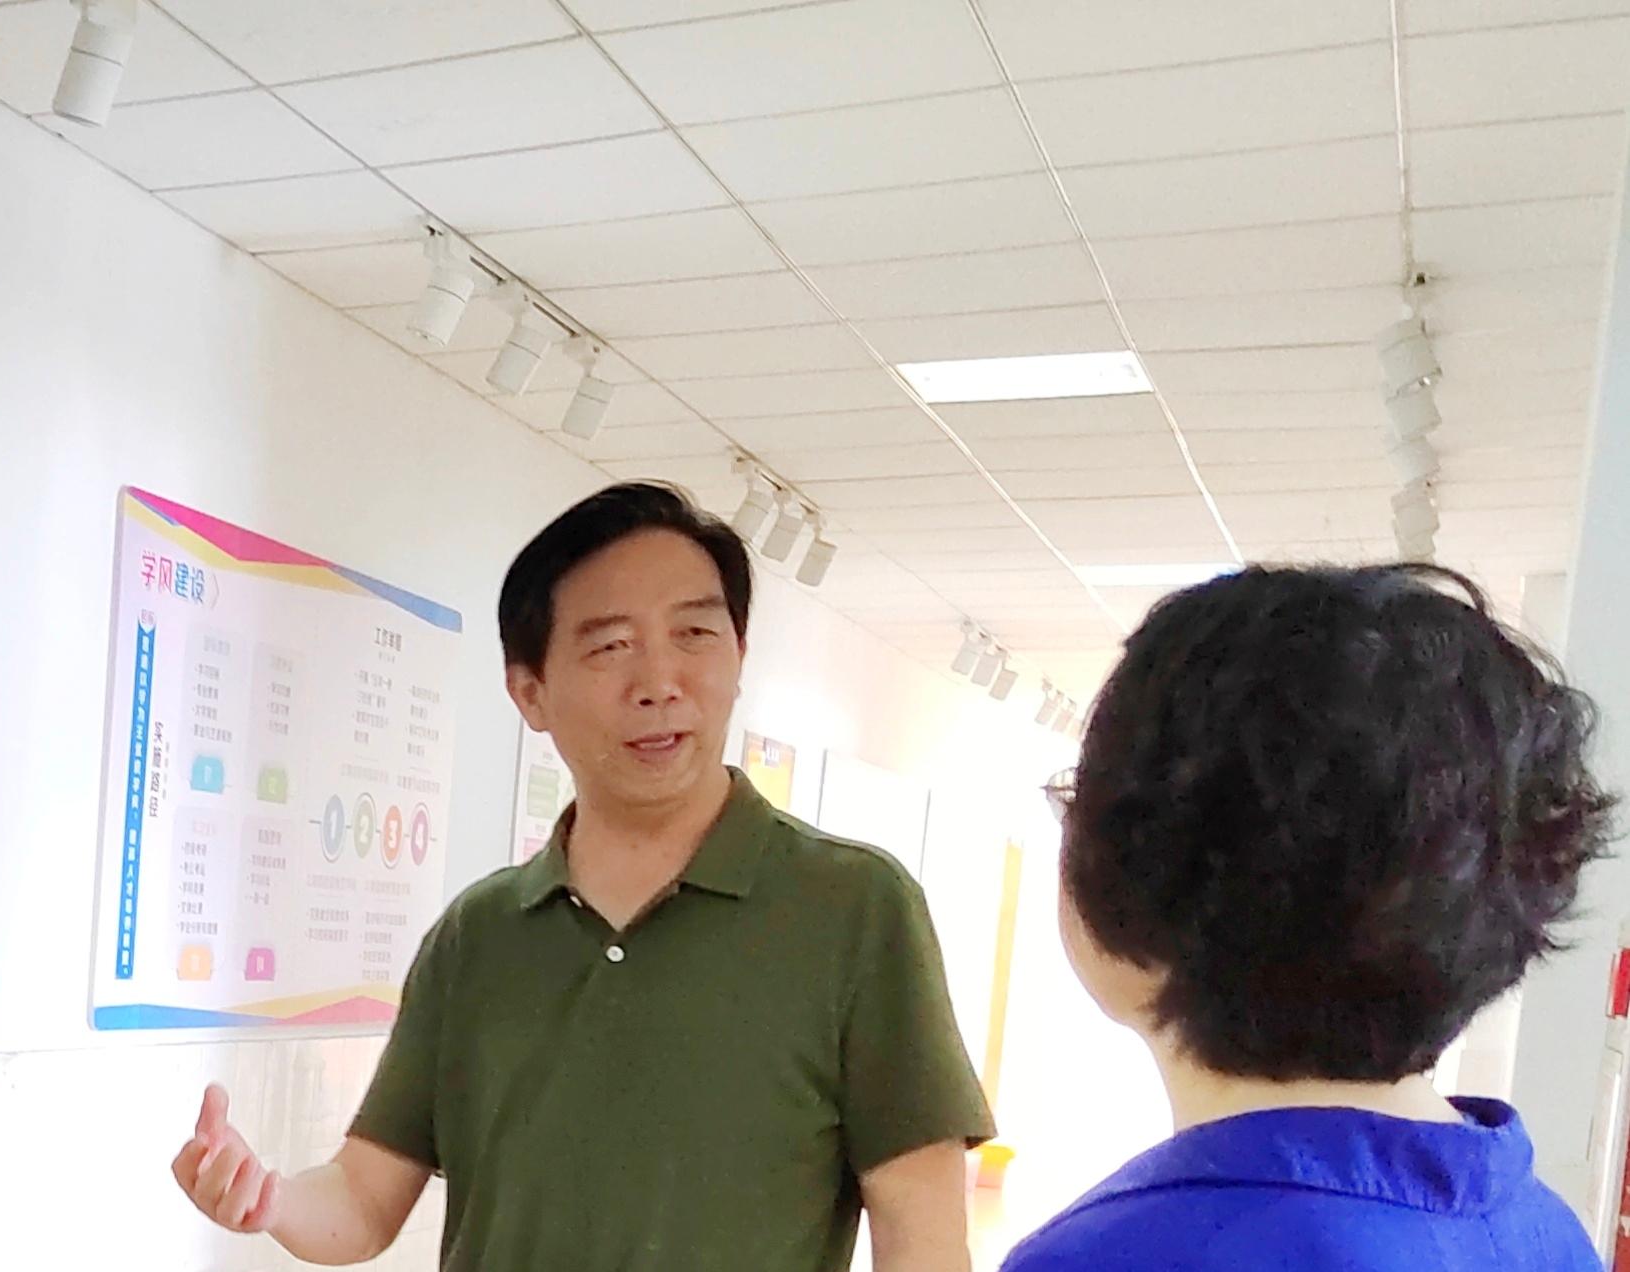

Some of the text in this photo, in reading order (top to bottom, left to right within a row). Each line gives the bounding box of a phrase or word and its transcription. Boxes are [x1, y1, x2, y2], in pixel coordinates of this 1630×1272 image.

[141, 550, 205, 604] 学风建设
[359, 815, 370, 844] 2
